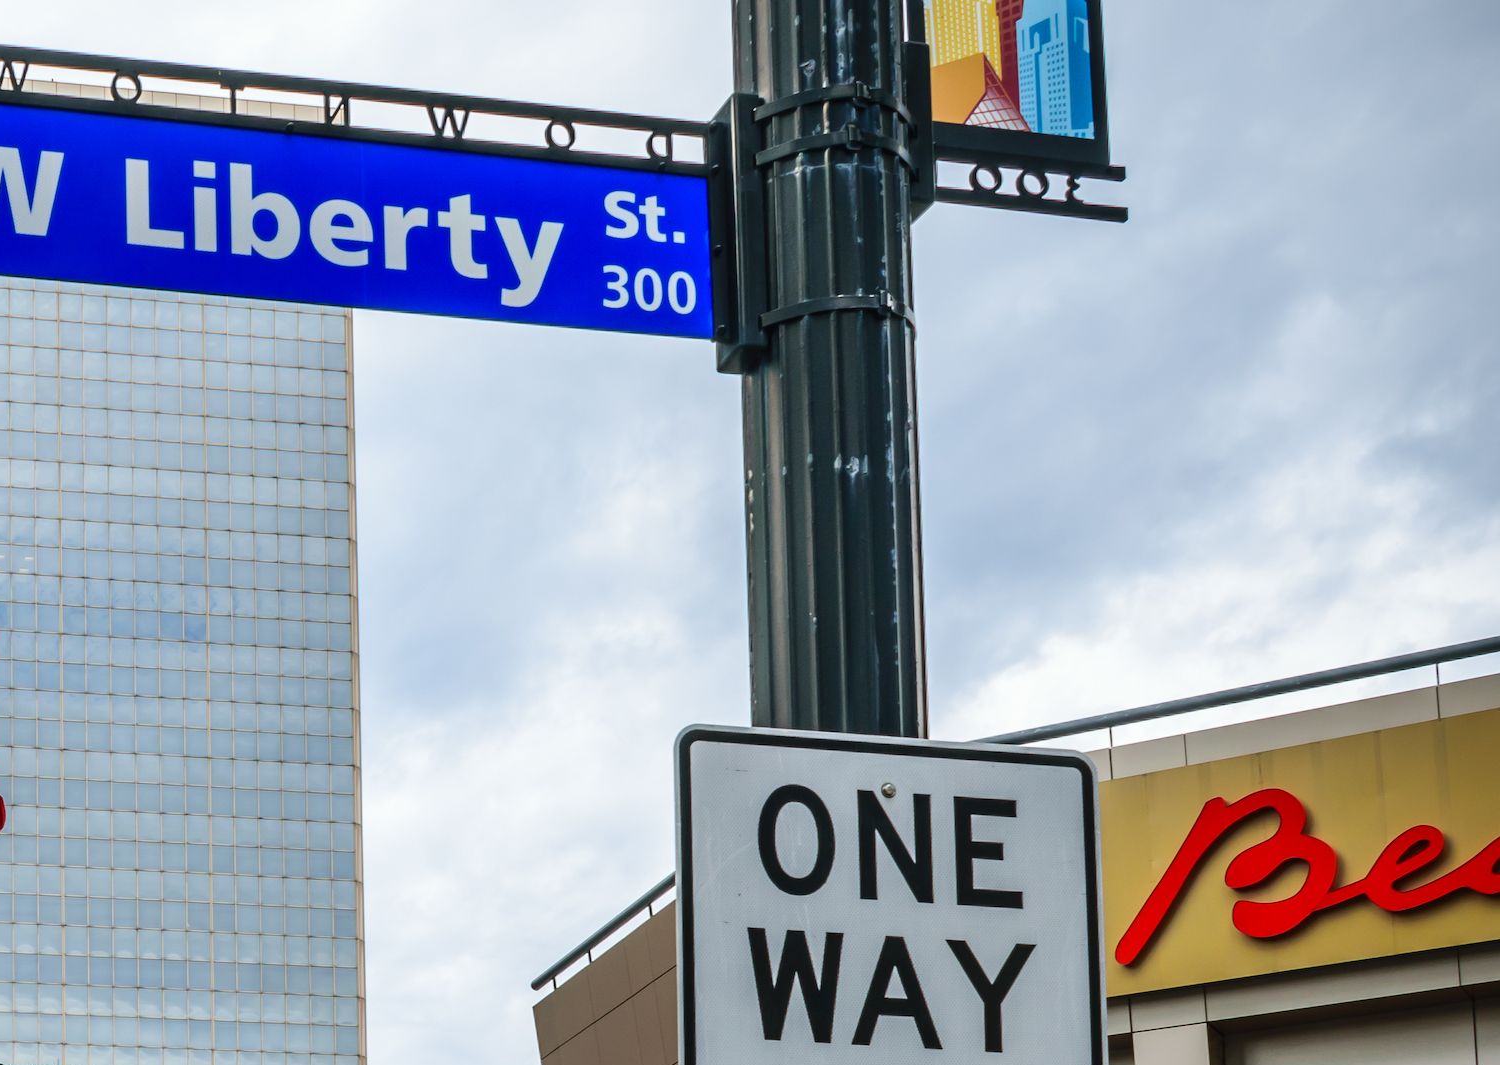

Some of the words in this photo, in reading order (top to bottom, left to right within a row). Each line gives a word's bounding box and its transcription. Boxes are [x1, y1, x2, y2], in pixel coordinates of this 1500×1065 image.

[125, 158, 564, 308] Liberty
[605, 191, 687, 244] St.
[602, 264, 696, 316] 300
[757, 783, 1025, 909] ONE
[747, 927, 1037, 1053] WAY
